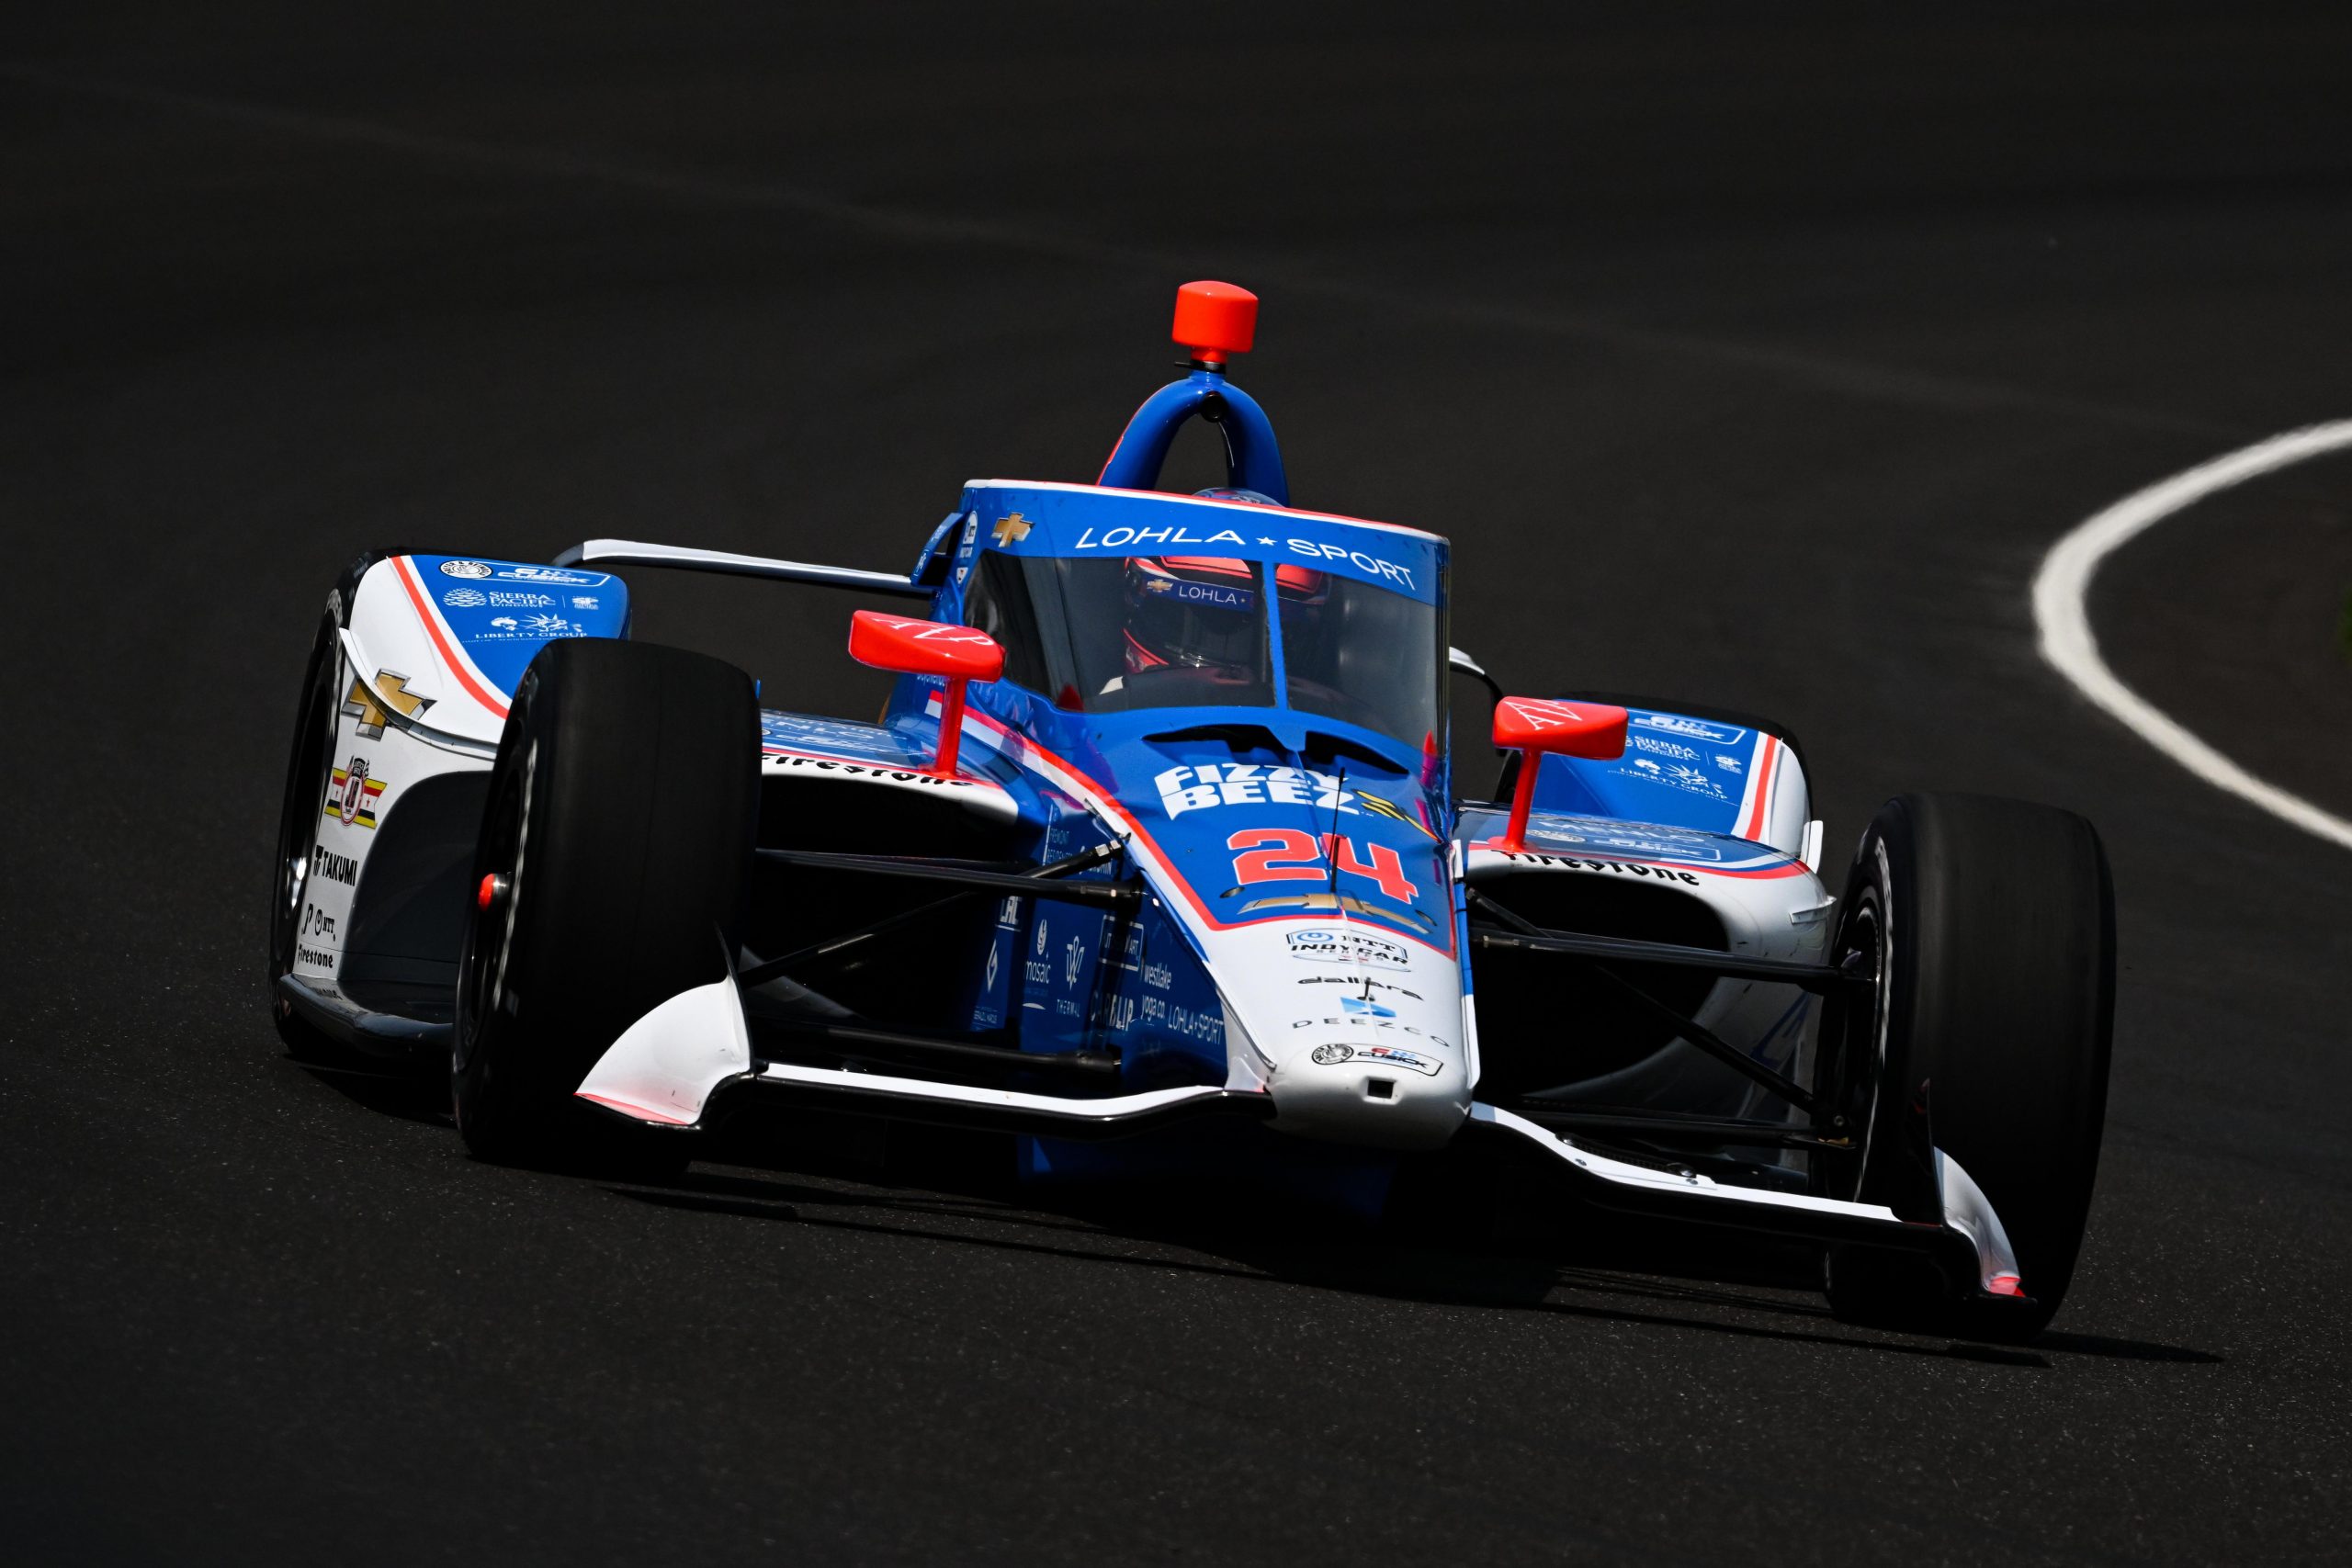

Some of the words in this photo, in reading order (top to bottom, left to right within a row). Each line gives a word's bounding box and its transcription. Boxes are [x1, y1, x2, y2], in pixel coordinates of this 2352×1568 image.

[1075, 525, 1246, 549] LOHLA
[1288, 538, 1416, 592] SPORT
[489, 591, 552, 600] SIERRA
[489, 596, 556, 606] PACIFIC
[1178, 585, 1237, 605] LOHLA
[1154, 762, 1349, 797] FIZZY
[1620, 767, 1677, 785] LIBERTY
[1680, 783, 1728, 799] GROUP
[1161, 781, 1360, 821] BEEZ
[322, 851, 358, 887] TAKUMI
[1227, 828, 1419, 905] 24
[297, 943, 334, 969] Firestone
[1291, 943, 1408, 964] INDYCAR
[1025, 957, 1051, 985] mosaic
[1144, 962, 1172, 990] westlake
[1140, 994, 1157, 1022] yoga
[1168, 1004, 1194, 1036] LOHLA
[1197, 1013, 1225, 1045] SPORT
[1292, 1018, 1450, 1048] DEEZCO
